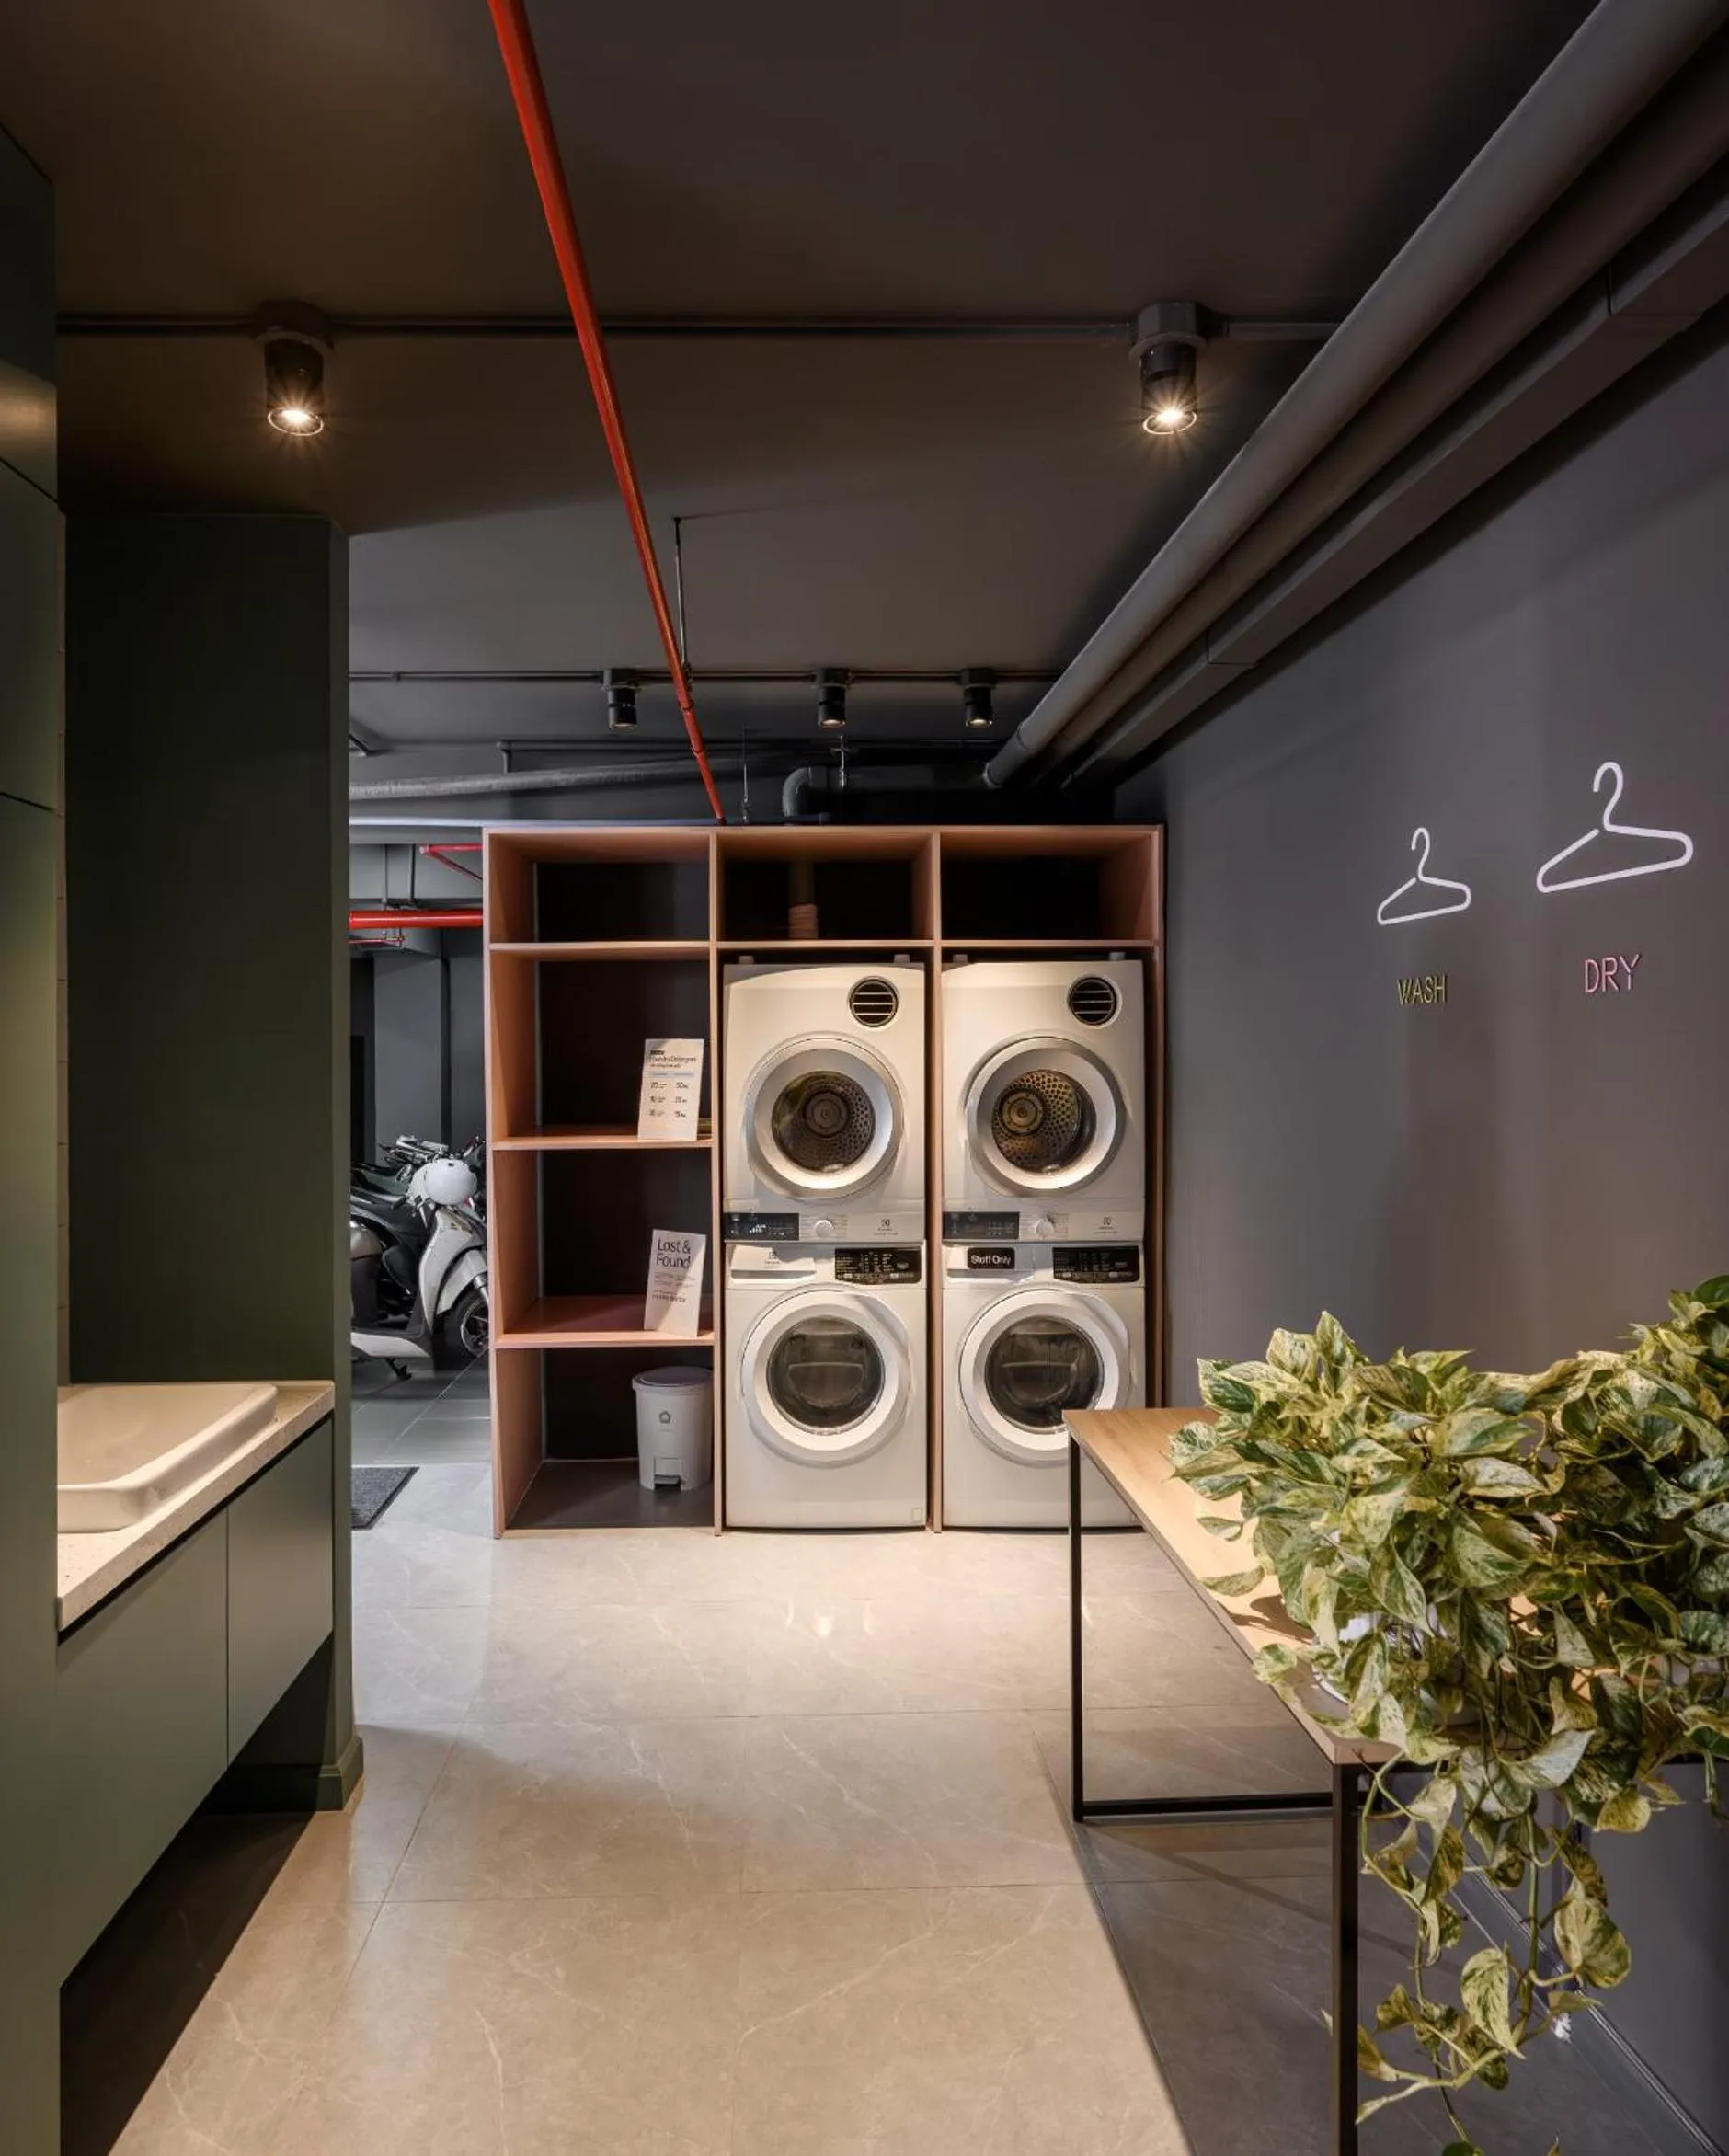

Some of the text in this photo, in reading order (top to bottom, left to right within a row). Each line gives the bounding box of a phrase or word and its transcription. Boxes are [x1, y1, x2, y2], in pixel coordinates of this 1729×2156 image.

[1584, 953, 1642, 993] DRY
[1396, 972, 1448, 1006] WASH
[658, 1237, 692, 1254] Lost &
[656, 1253, 692, 1269] Found
[970, 1254, 1012, 1266] Staff Only
